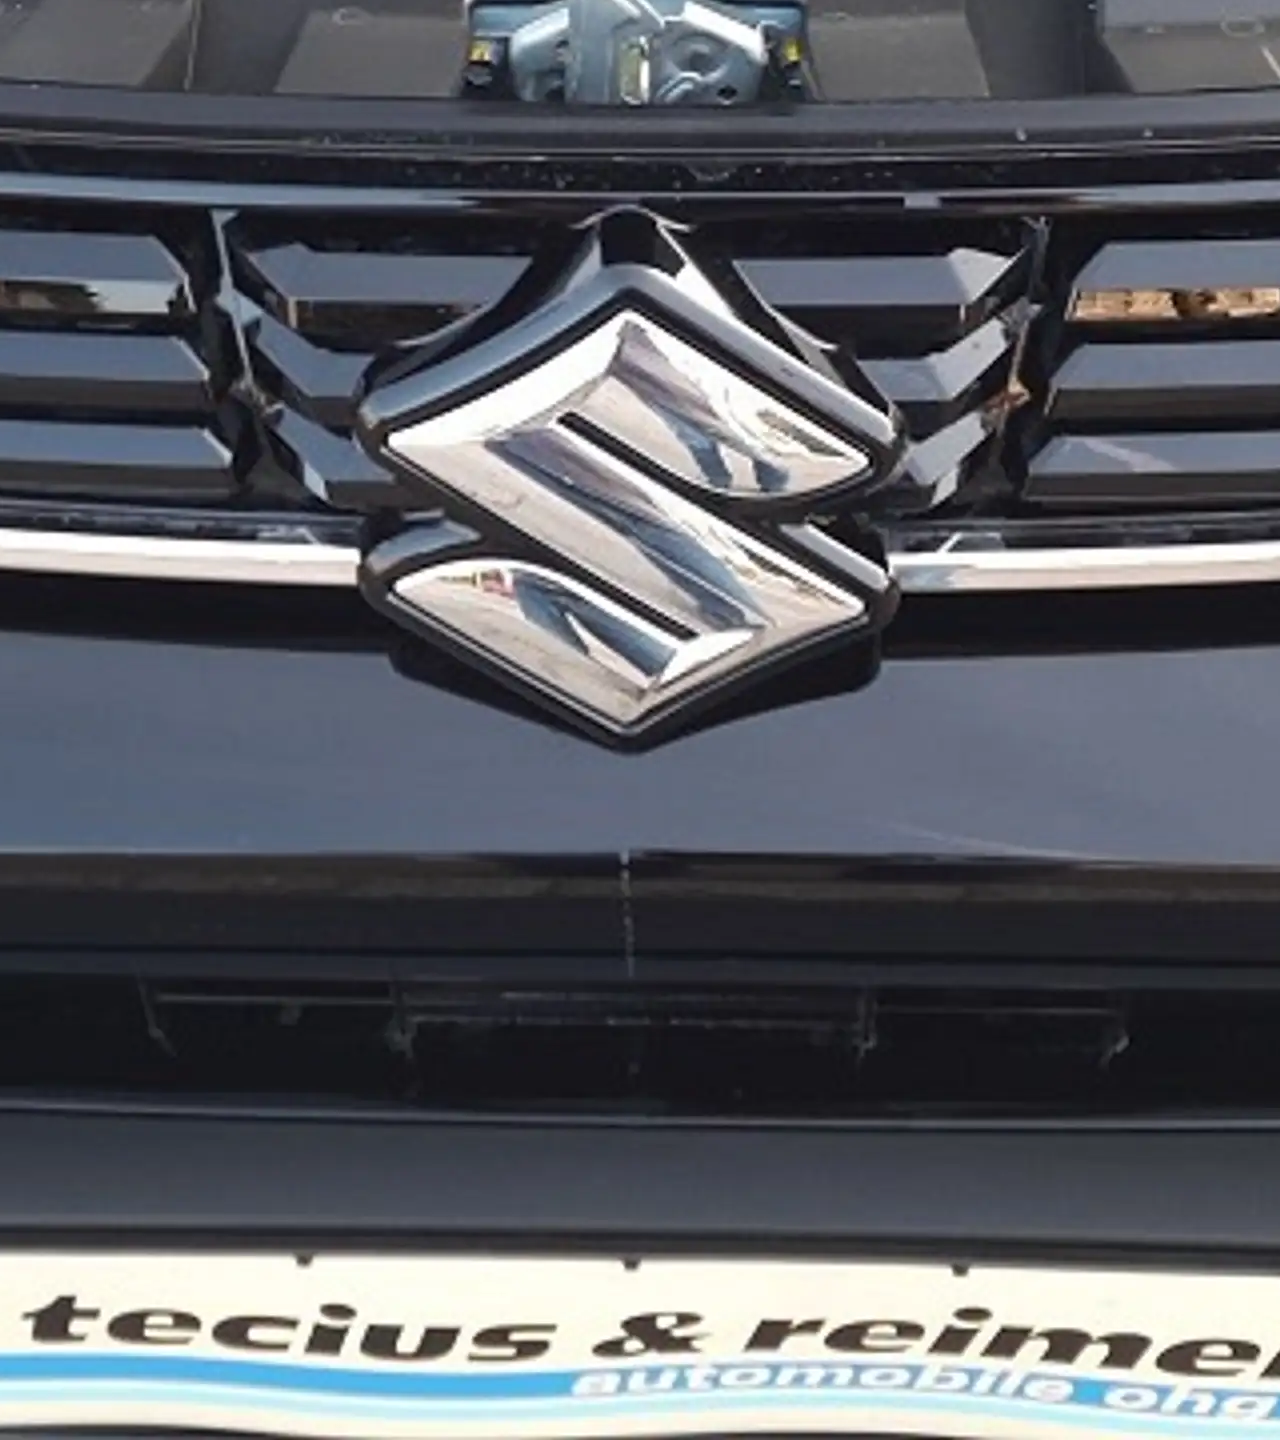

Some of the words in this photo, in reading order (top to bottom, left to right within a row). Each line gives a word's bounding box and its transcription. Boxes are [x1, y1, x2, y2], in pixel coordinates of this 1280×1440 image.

[22, 1295, 557, 1361] tecius
[592, 1311, 713, 1359] &
[570, 1363, 1074, 1405] automobile
[1103, 1386, 1279, 1422] ohg
